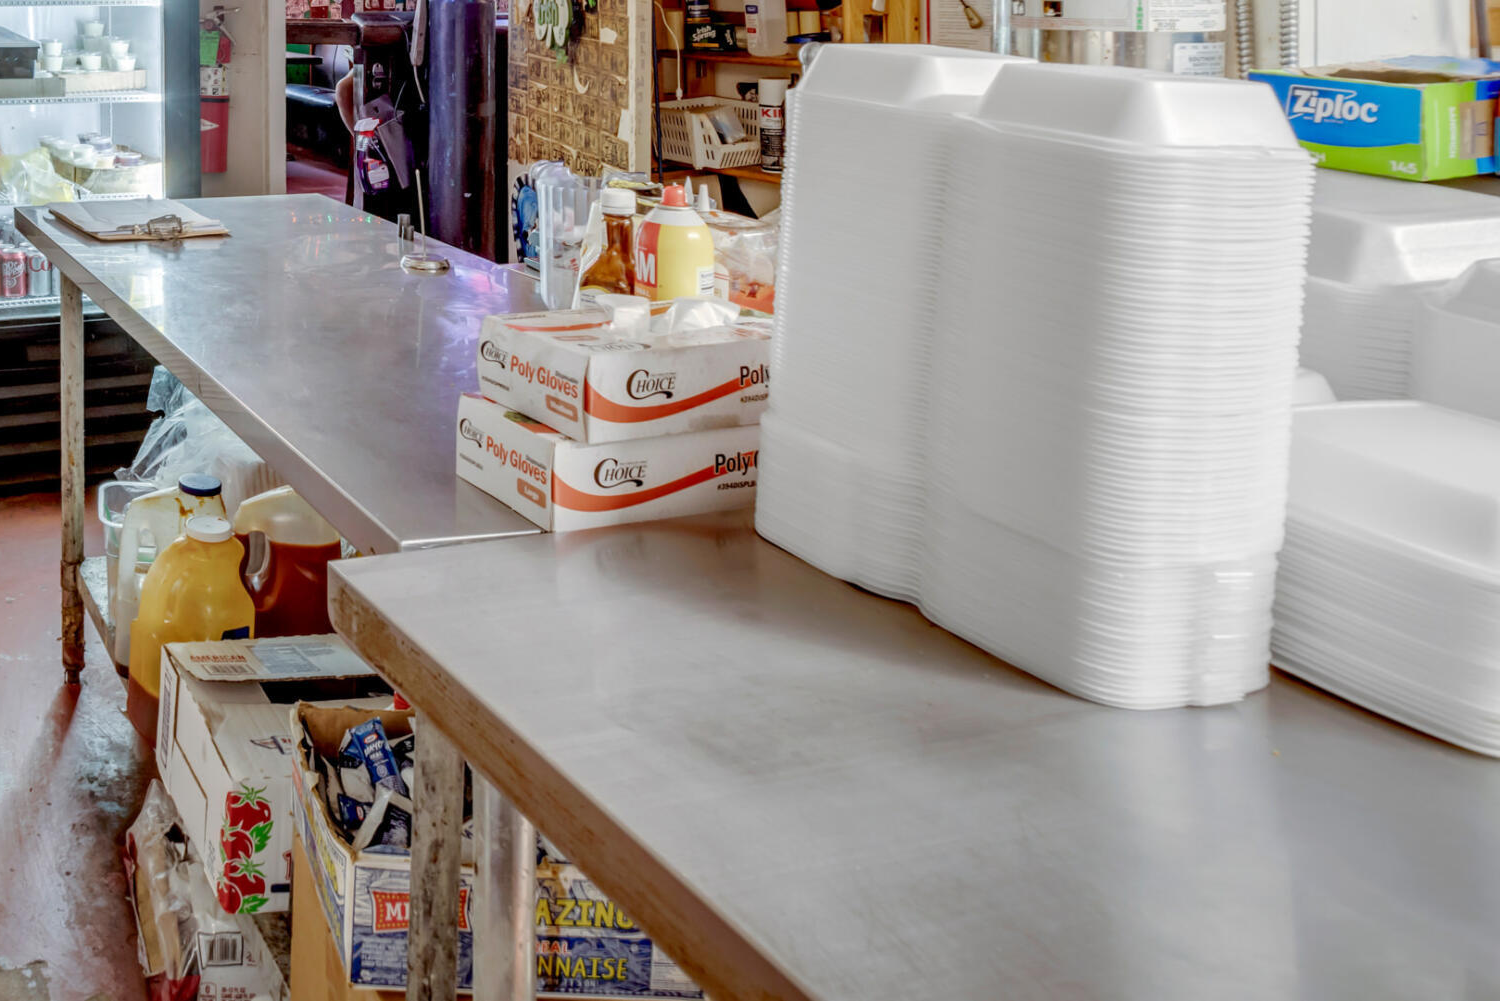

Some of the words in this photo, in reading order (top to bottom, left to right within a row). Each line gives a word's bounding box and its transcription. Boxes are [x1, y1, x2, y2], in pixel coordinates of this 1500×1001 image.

[692, 30, 717, 42] Spring
[696, 25, 712, 34] Irish
[1292, 89, 1379, 124] Ziploc
[510, 355, 536, 384] Poly
[537, 366, 579, 399] Gloves
[626, 369, 676, 400] CHOICE
[486, 435, 509, 466] Poly
[510, 449, 548, 485] Gloves
[594, 458, 648, 489] CHOICE
[715, 451, 751, 476] Poly
[537, 955, 628, 982] NNAISE
